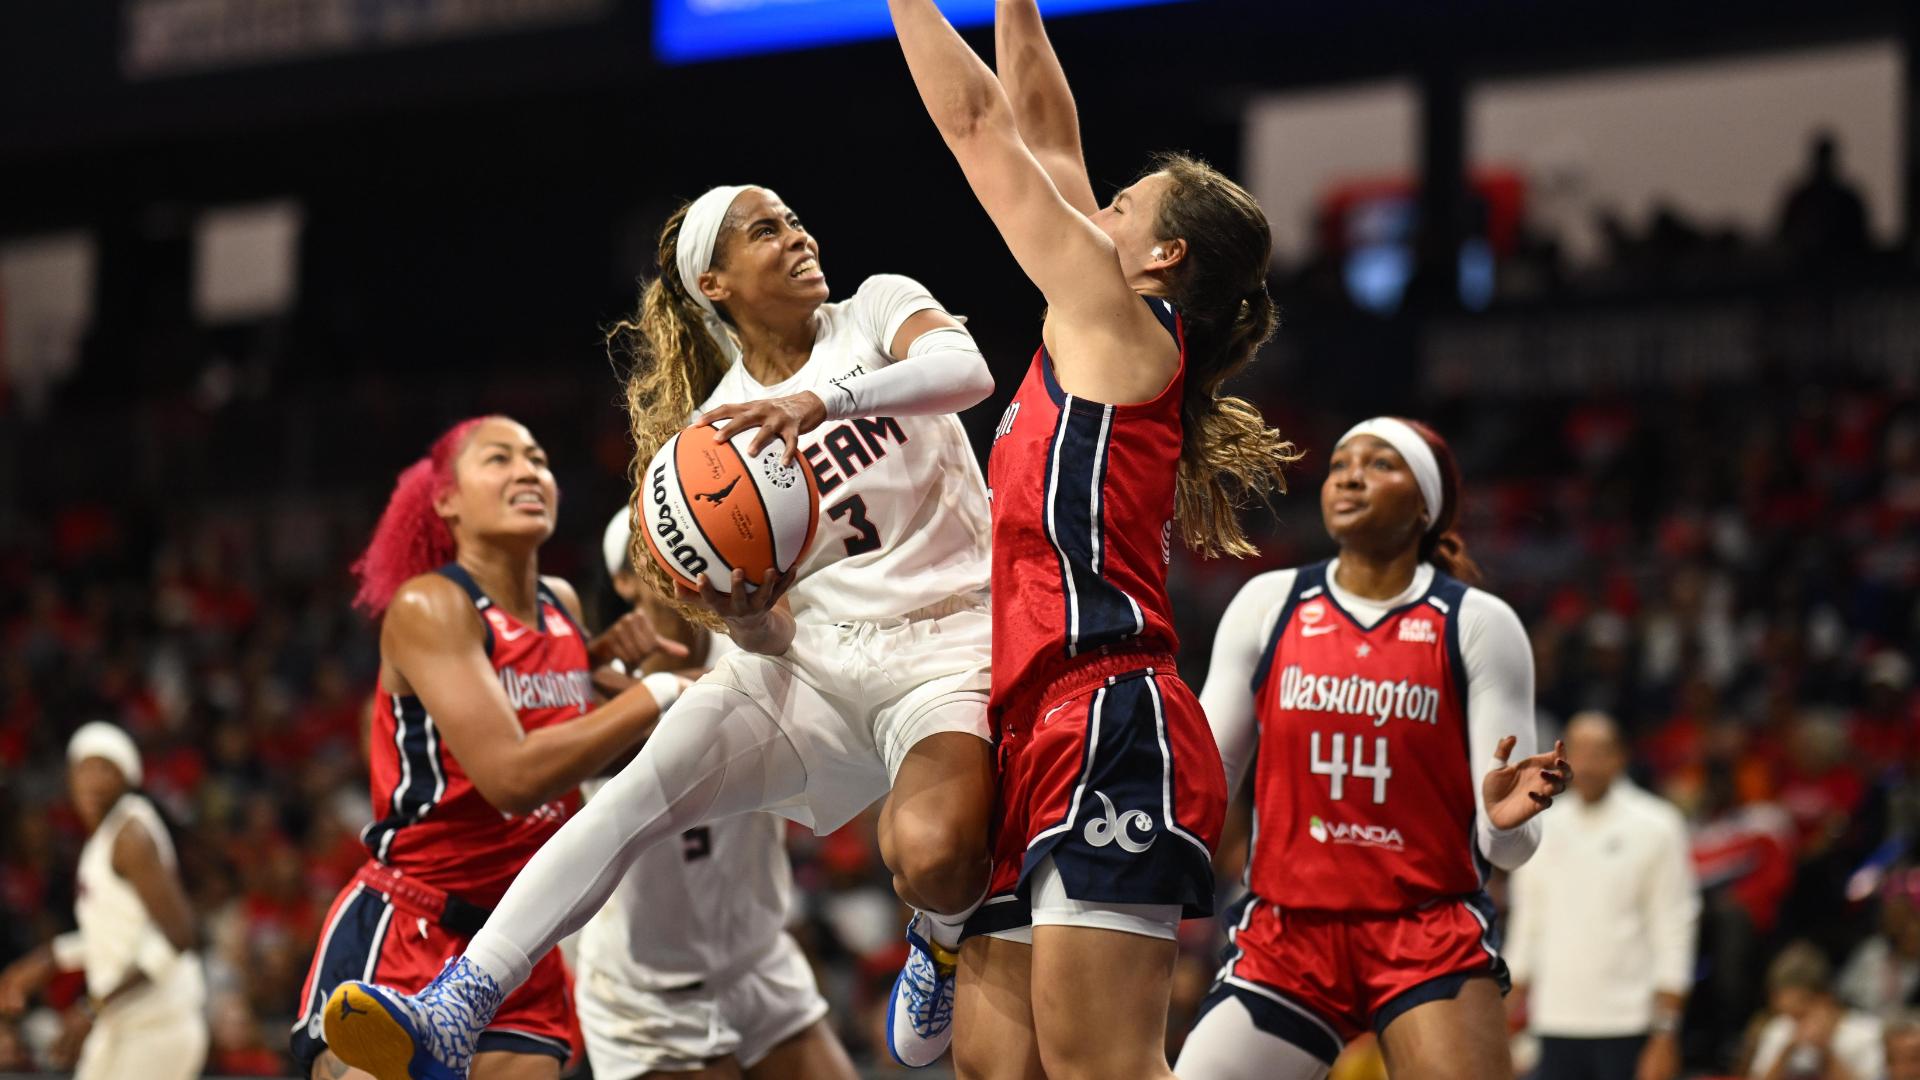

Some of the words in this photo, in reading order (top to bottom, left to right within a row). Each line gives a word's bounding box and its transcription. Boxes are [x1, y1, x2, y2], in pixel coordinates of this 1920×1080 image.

[804, 417, 909, 498] EAM
[827, 494, 882, 556] 3
[1280, 665, 1439, 727] Washington
[1310, 731, 1391, 804] 44
[1326, 821, 1404, 846] VANDA
